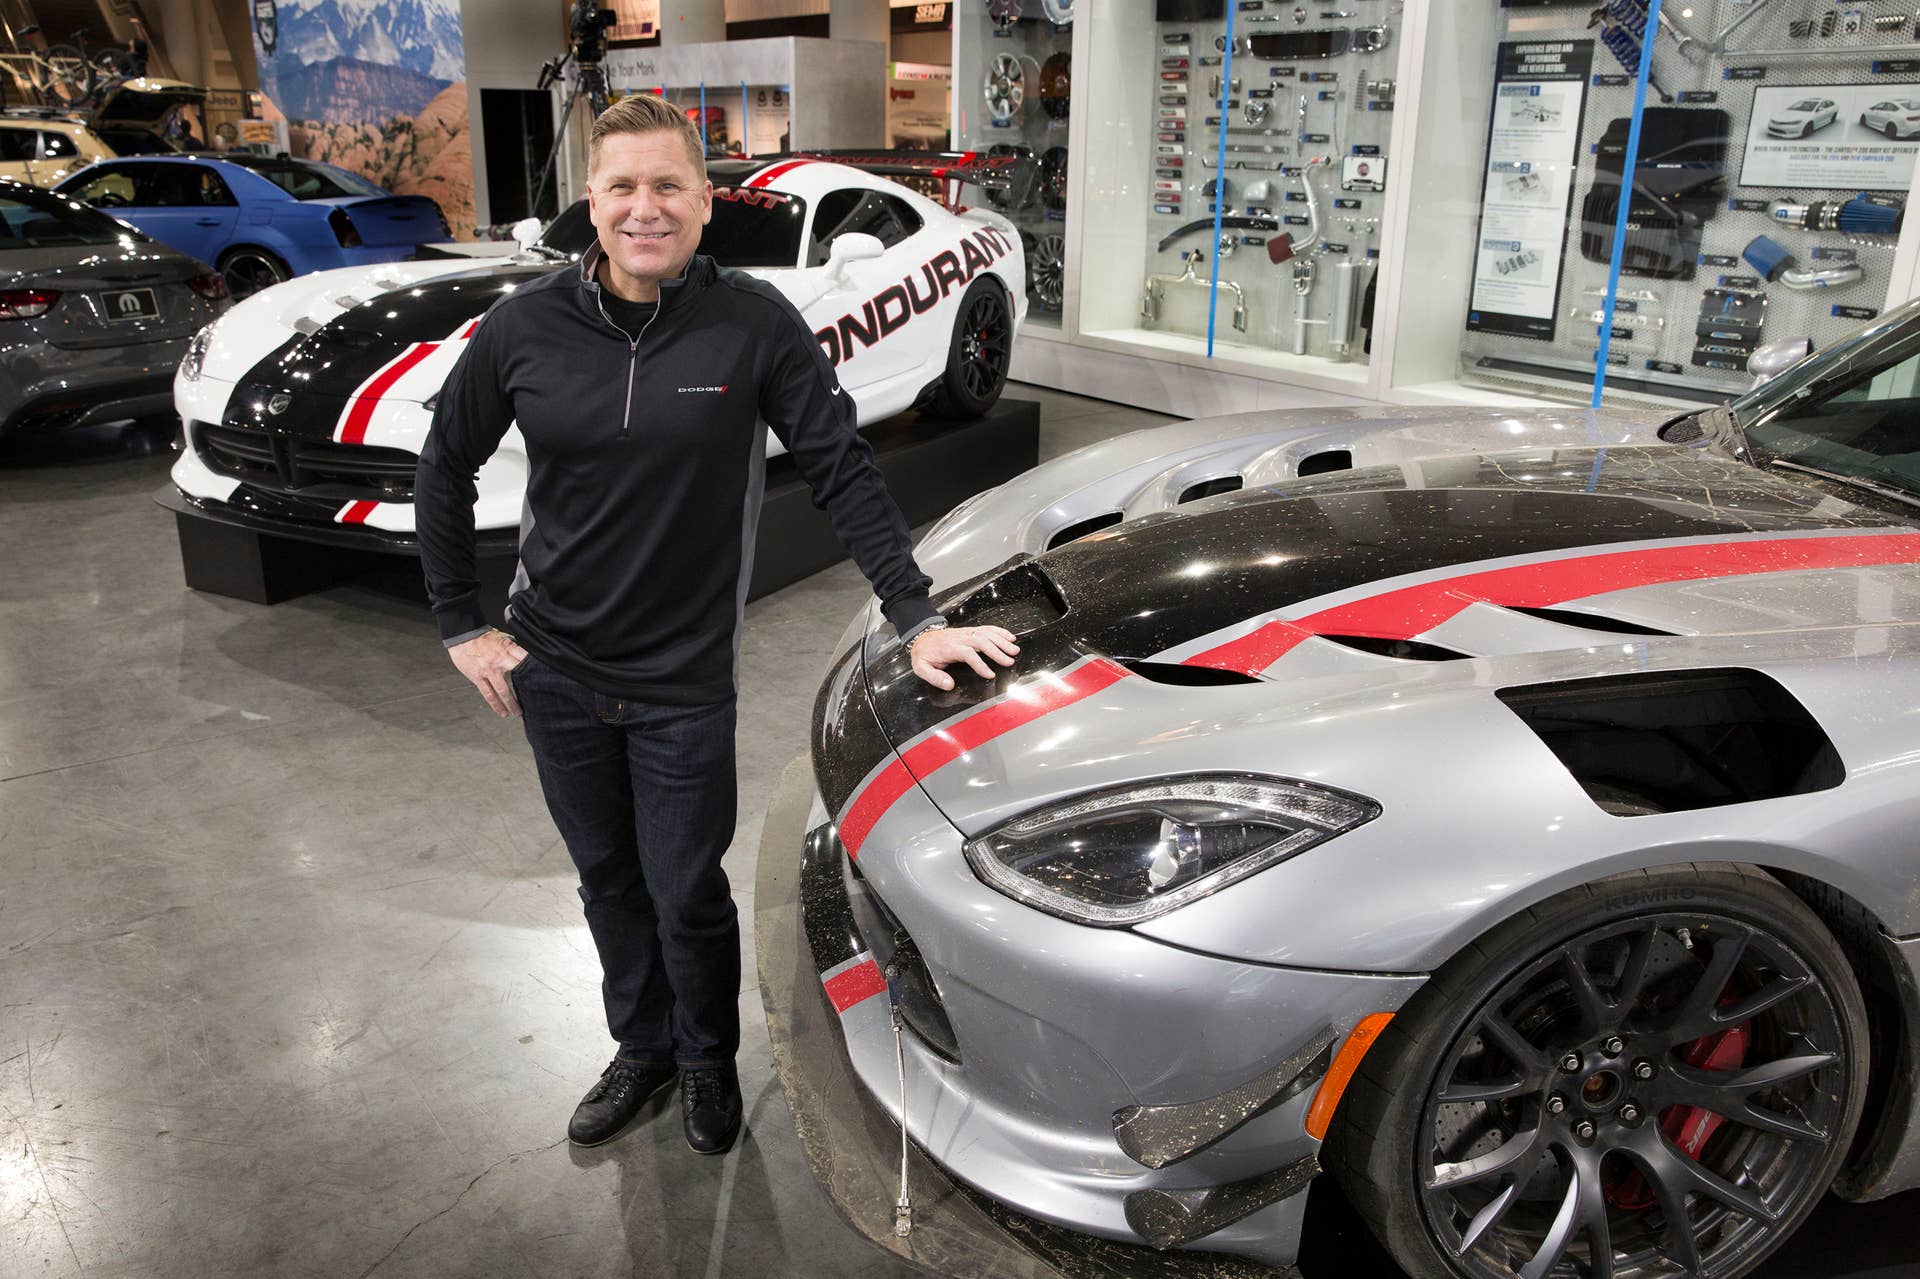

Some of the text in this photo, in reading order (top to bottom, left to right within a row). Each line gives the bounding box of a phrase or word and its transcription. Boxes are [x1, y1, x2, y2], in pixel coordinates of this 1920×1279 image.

[1562, 43, 1574, 53] AND
[636, 59, 656, 76] Mark
[208, 93, 238, 107] Jeep
[712, 186, 788, 209] ANT
[813, 225, 1013, 369] ONDURANT
[1602, 887, 1697, 912] KUMHO
